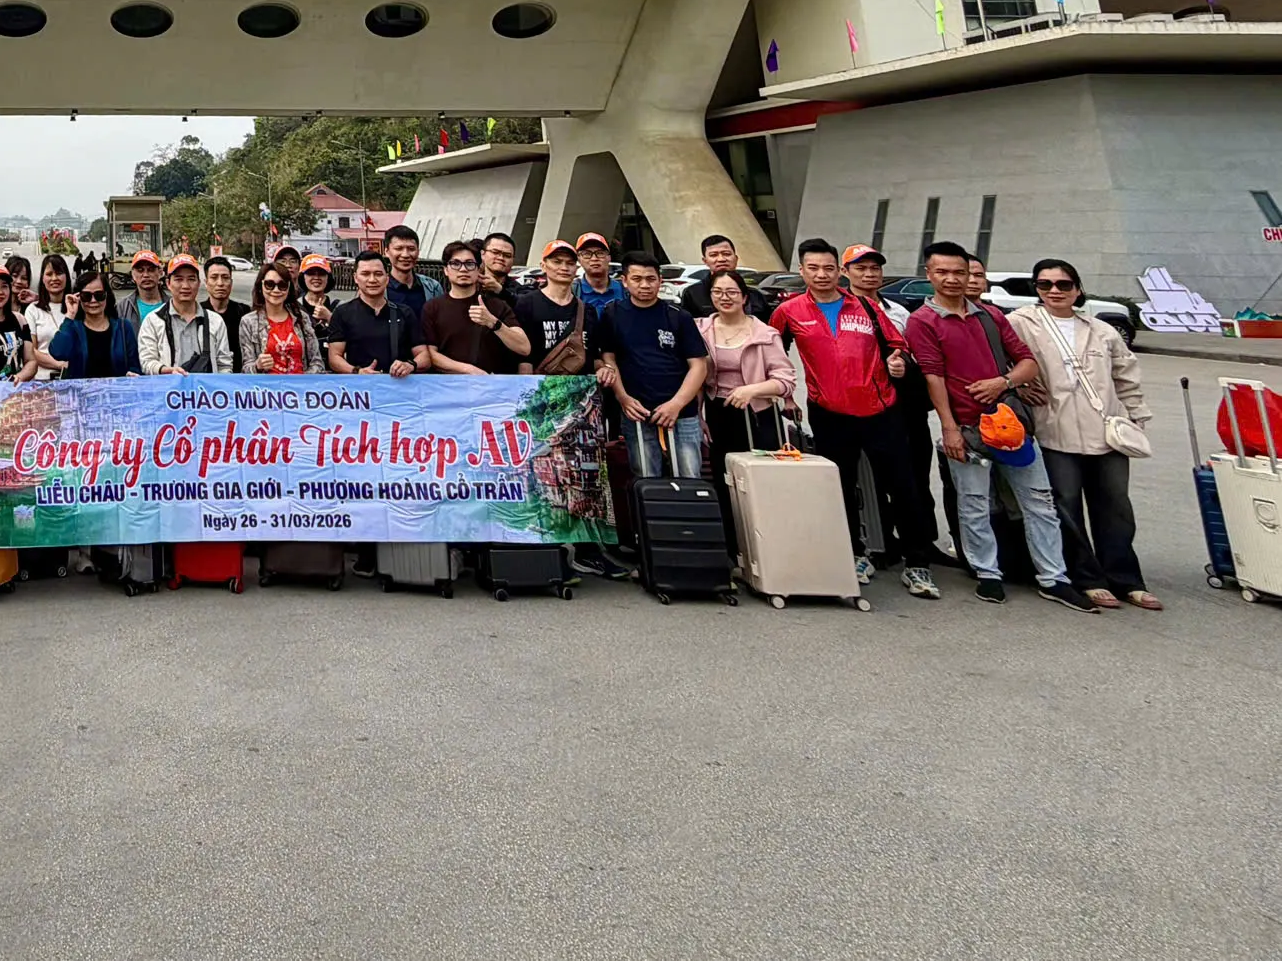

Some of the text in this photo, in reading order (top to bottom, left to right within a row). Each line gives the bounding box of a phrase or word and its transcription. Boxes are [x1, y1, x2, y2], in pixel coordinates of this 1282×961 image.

[543, 321, 556, 331] MY
[167, 387, 371, 410] CHÀO MỪNG ĐOÀN
[14, 415, 532, 488] Công ty Cổ phần Tích hợp AV
[36, 479, 75, 505] LIỄU
[79, 483, 126, 504] CHÂU
[141, 480, 209, 502] TRƯƠNG
[213, 482, 243, 500] GIA
[247, 478, 282, 500] GIỚI
[299, 479, 374, 504] PHƯỢNG
[378, 477, 443, 501] HOÀNG
[446, 473, 470, 500] CỔ
[473, 473, 524, 501] TRẤN
[203, 514, 237, 530] Ngày
[240, 514, 258, 528] 26
[270, 513, 352, 528] 31/03/2026
